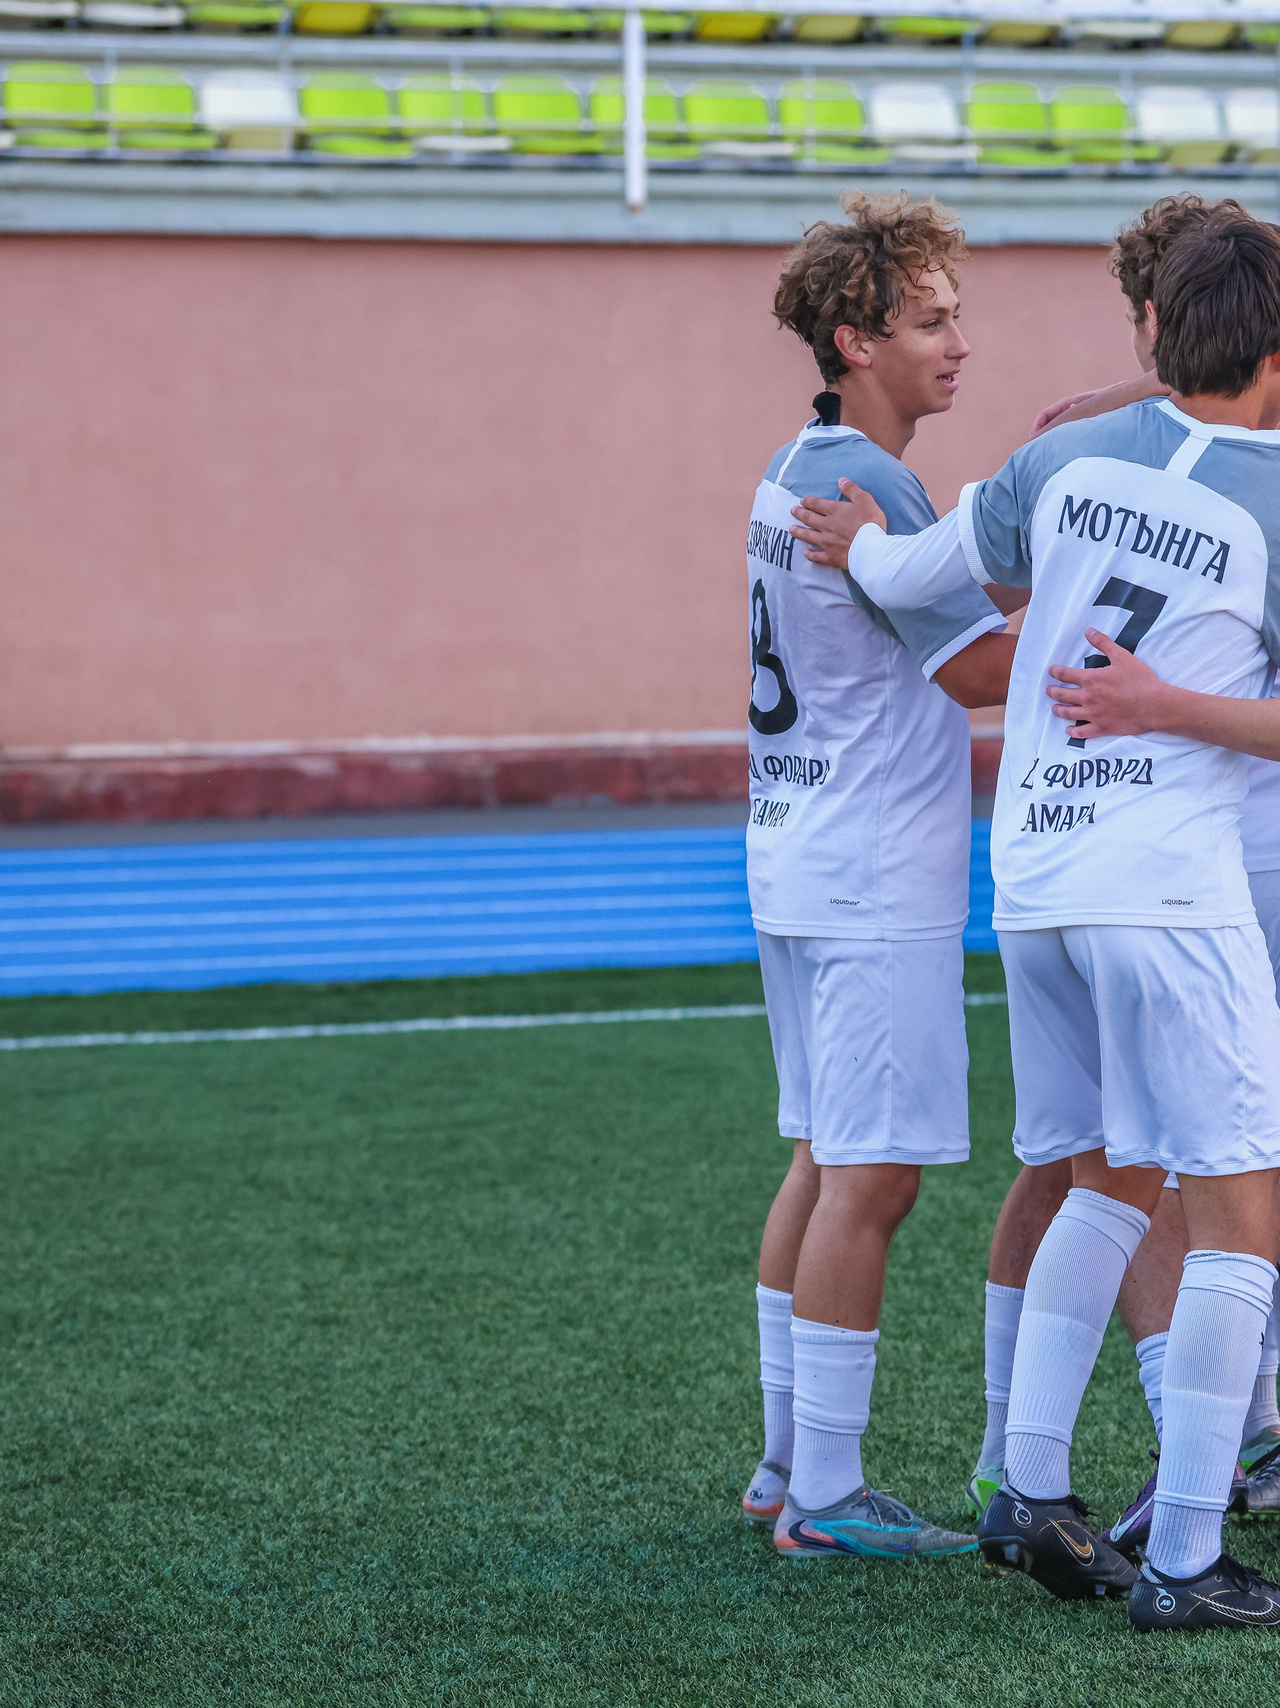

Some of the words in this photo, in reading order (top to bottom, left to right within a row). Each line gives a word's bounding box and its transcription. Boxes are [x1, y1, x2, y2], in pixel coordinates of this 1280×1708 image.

[1057, 494, 1231, 585] МОТЫНГА
[748, 578, 798, 735] 8
[1067, 576, 1168, 749] 7
[1021, 801, 1097, 833] АМАРА
